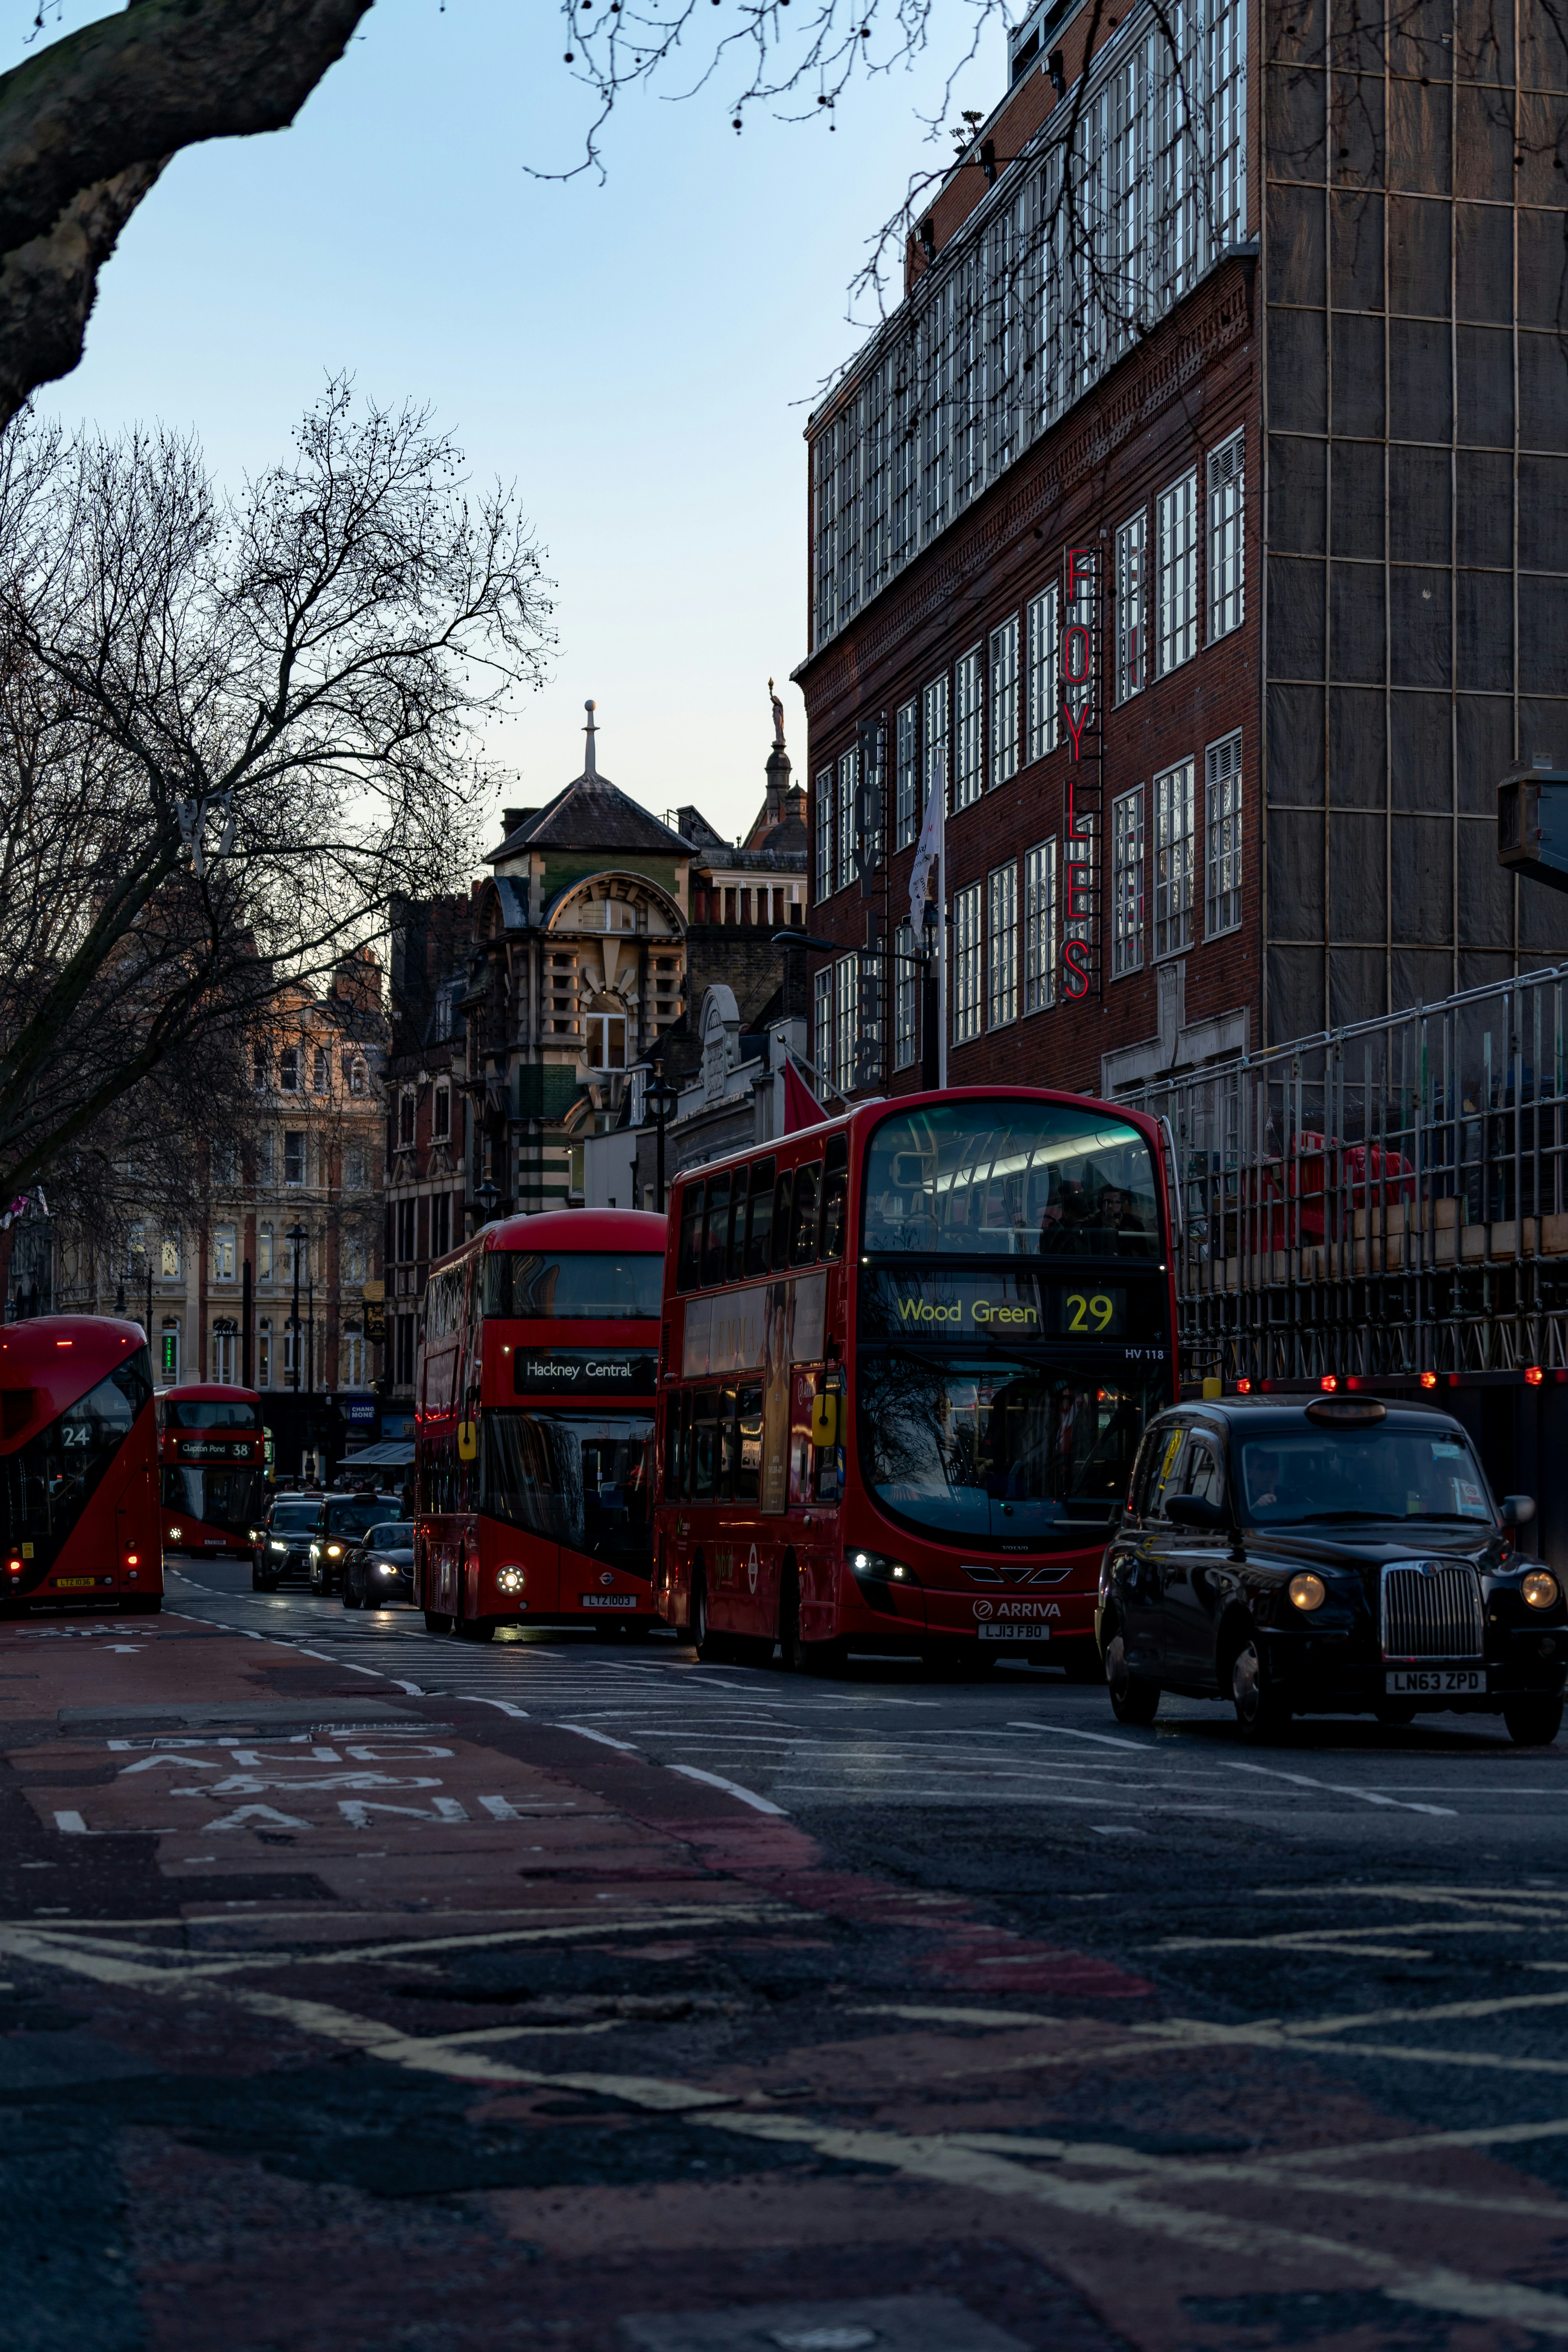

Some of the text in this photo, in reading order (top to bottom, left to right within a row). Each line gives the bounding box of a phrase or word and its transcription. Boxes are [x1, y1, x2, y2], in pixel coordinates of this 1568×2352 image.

[1059, 544, 1094, 1002] FOYLES
[898, 1295, 1113, 1331] Wood Green 29
[1125, 1349, 1164, 1360] HV 118
[527, 1362, 632, 1380] Hackney Central
[63, 1427, 90, 1446] 24
[182, 1444, 208, 1453] Clapton
[233, 1444, 248, 1456] 38
[715, 1544, 733, 1591] hybrid
[997, 1603, 1061, 1617] ARRIVA
[986, 1625, 1014, 1637] LJ13
[1395, 1672, 1478, 1690] LN63 ZPD
[117, 1745, 457, 1774] AND
[52, 1795, 602, 1835] LANE
